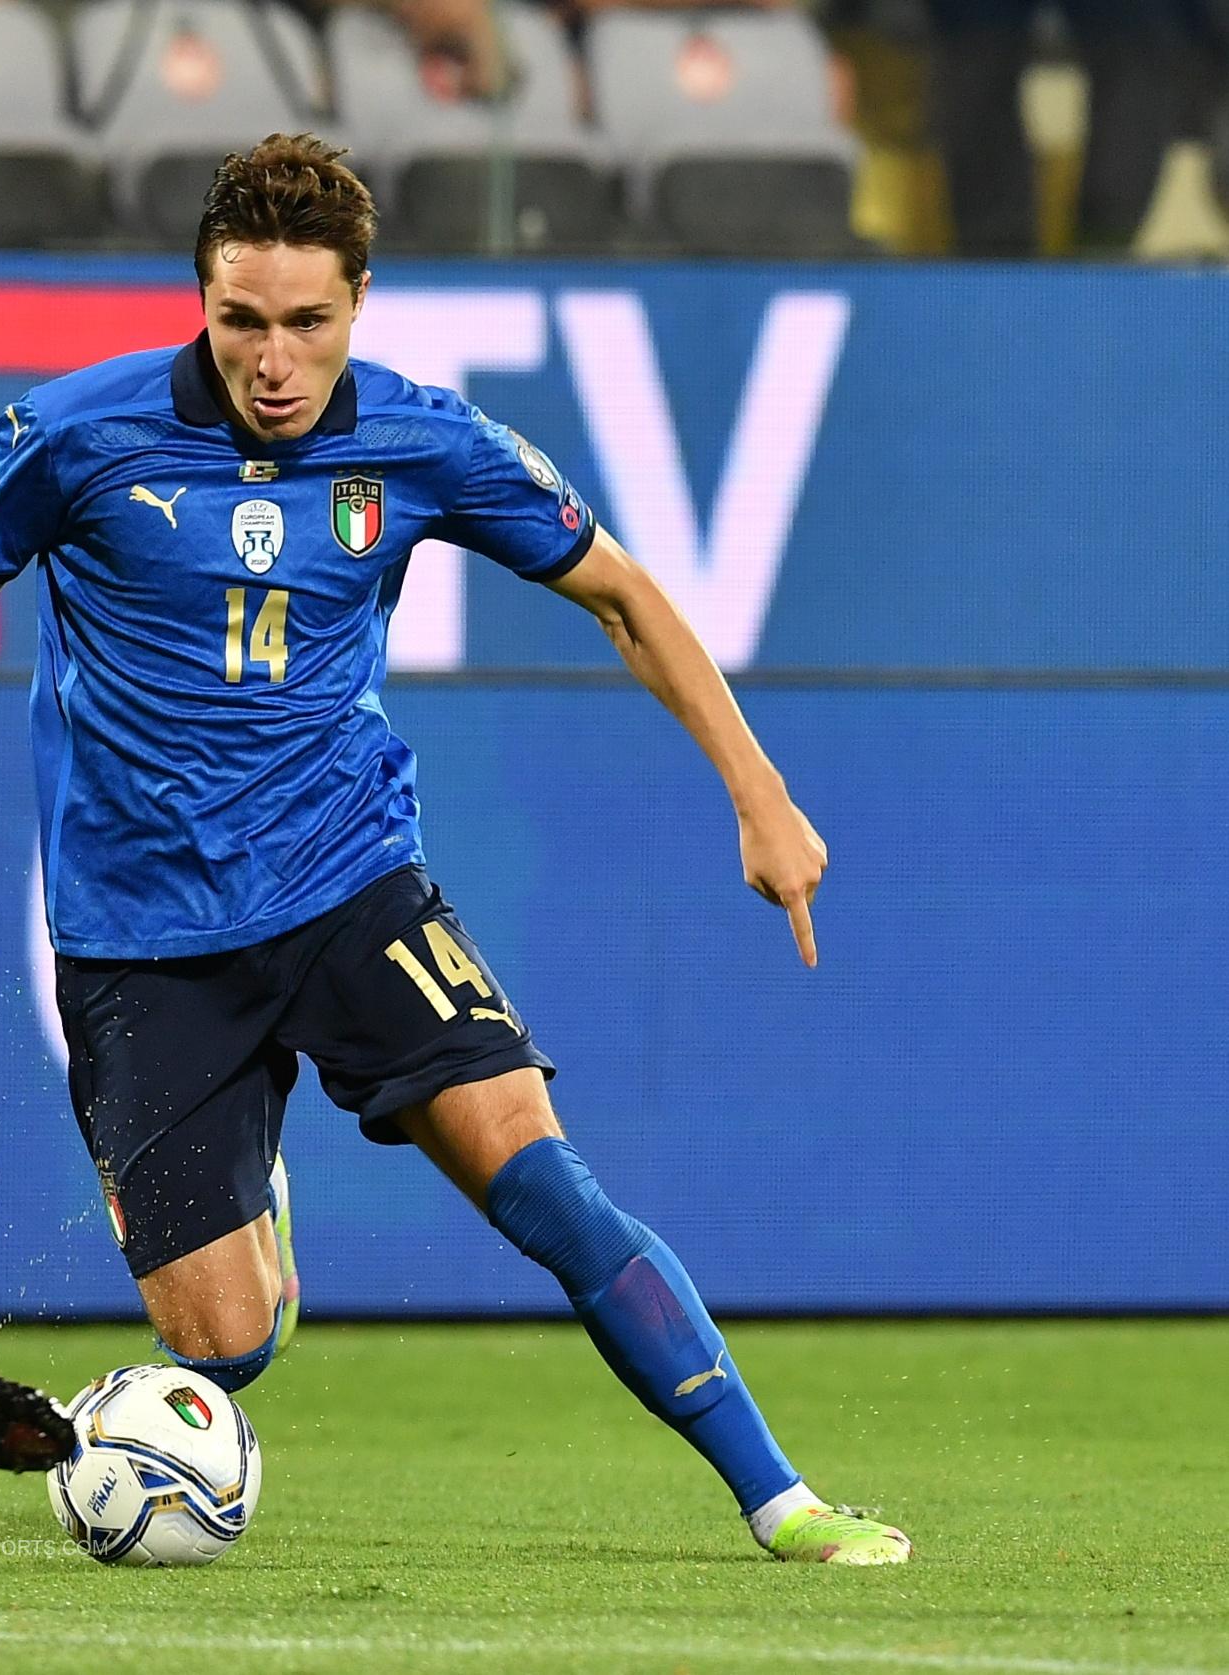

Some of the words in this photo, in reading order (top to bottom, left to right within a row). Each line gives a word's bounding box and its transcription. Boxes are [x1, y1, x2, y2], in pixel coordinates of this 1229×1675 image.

[336, 483, 378, 497] ITALIA
[225, 587, 289, 684] 14
[384, 920, 493, 1022] 14
[92, 1475, 118, 1518] FINAL
